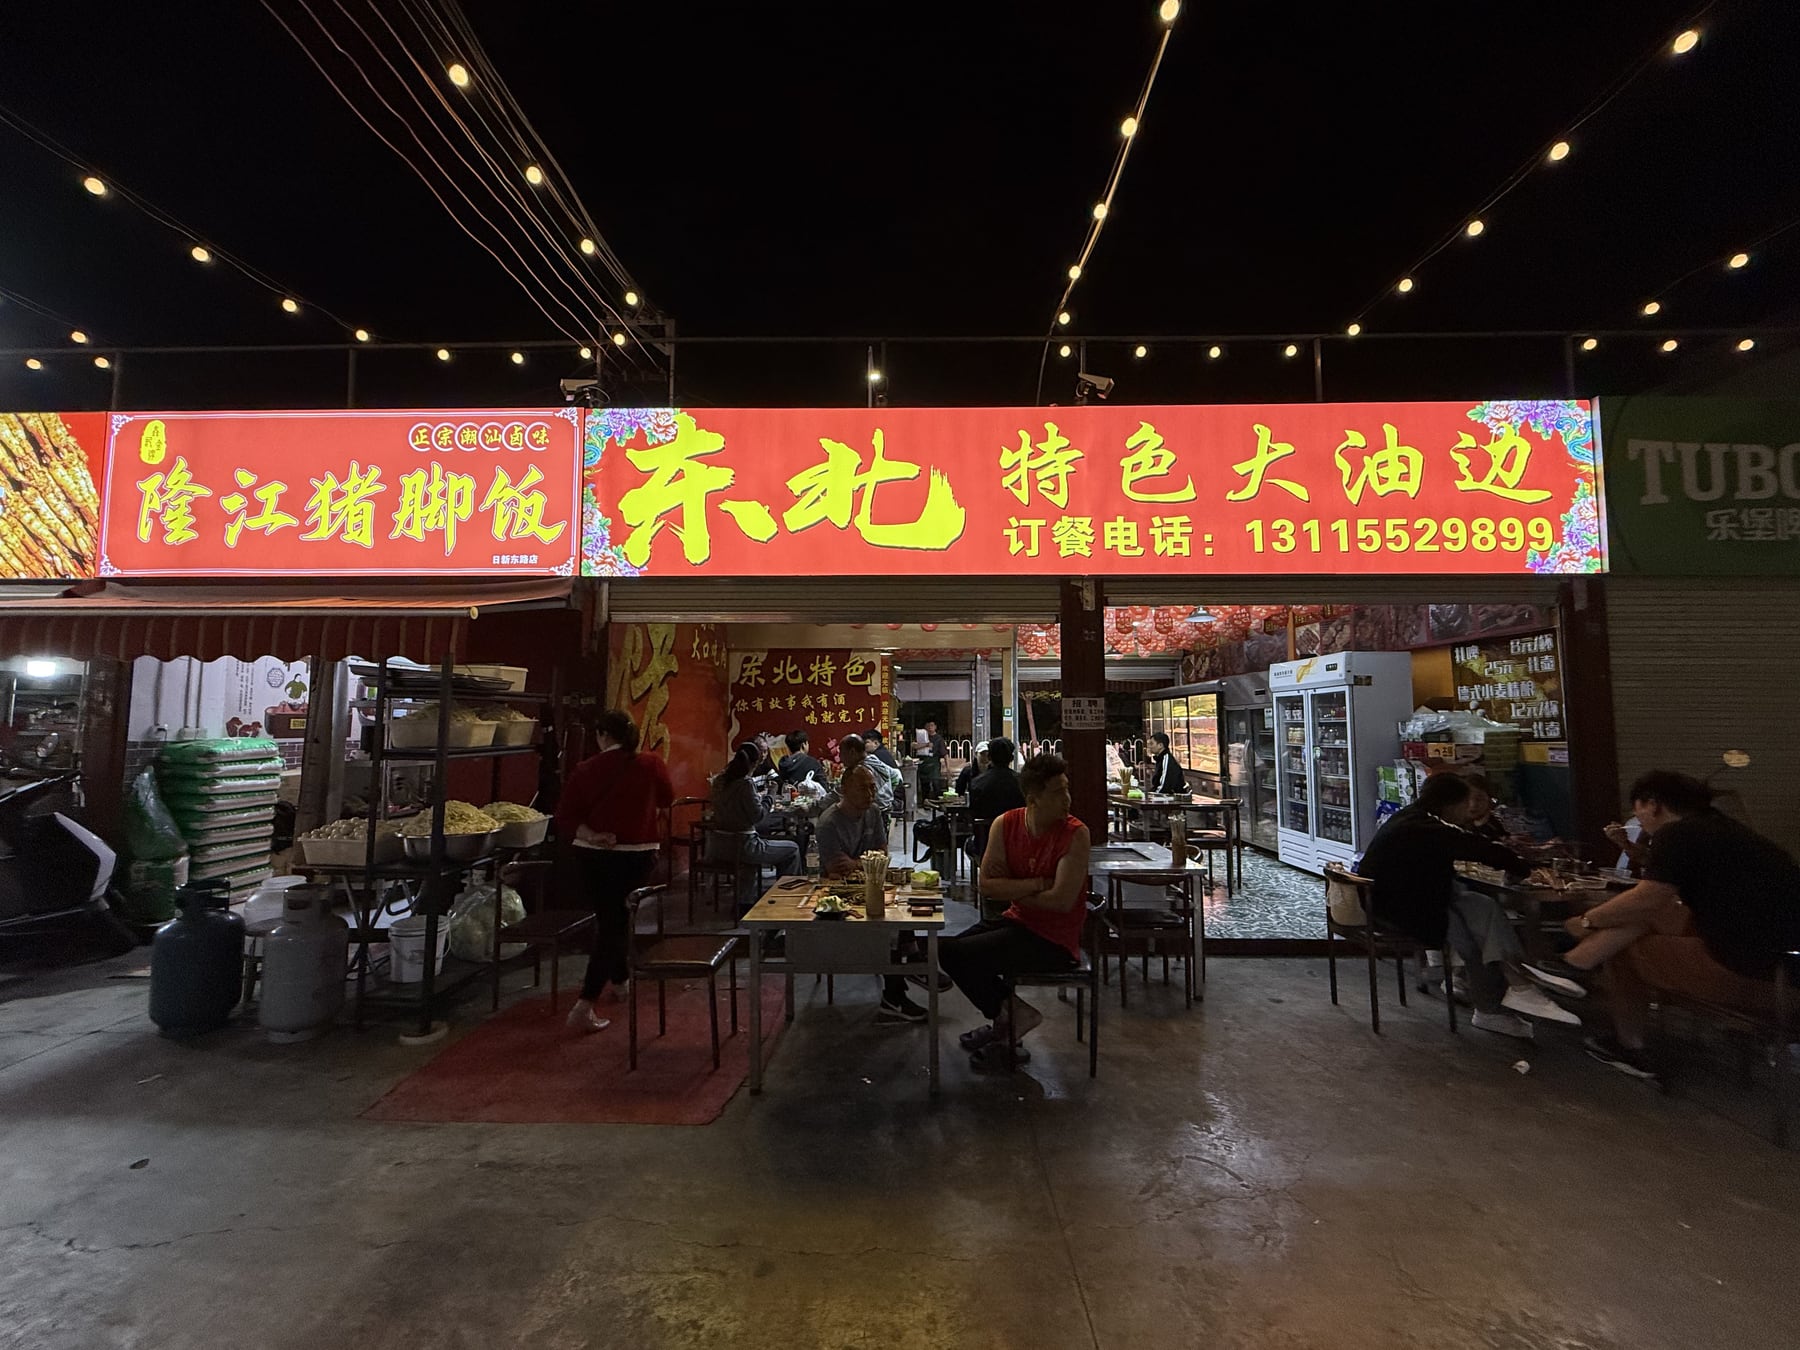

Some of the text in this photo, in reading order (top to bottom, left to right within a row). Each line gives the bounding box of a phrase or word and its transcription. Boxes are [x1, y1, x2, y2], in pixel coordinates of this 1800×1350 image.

[411, 424, 552, 449] 正宗潮汕卤味
[998, 420, 1554, 506] 特色大油边
[617, 411, 967, 567] 东北
[136, 455, 567, 556] 隆江猪脚饭
[1245, 515, 1554, 556] 13115529899
[492, 554, 539, 565] 日新东路店
[1454, 645, 1480, 663] 扎啤
[738, 655, 872, 688] 东北特色
[735, 692, 847, 713] 你有故事我有酒
[1457, 680, 1537, 703] 德式小麦精酿
[1072, 699, 1098, 708] 招聘
[1510, 699, 1559, 719] 12元/杯
[804, 707, 876, 726] 喝就完了！
